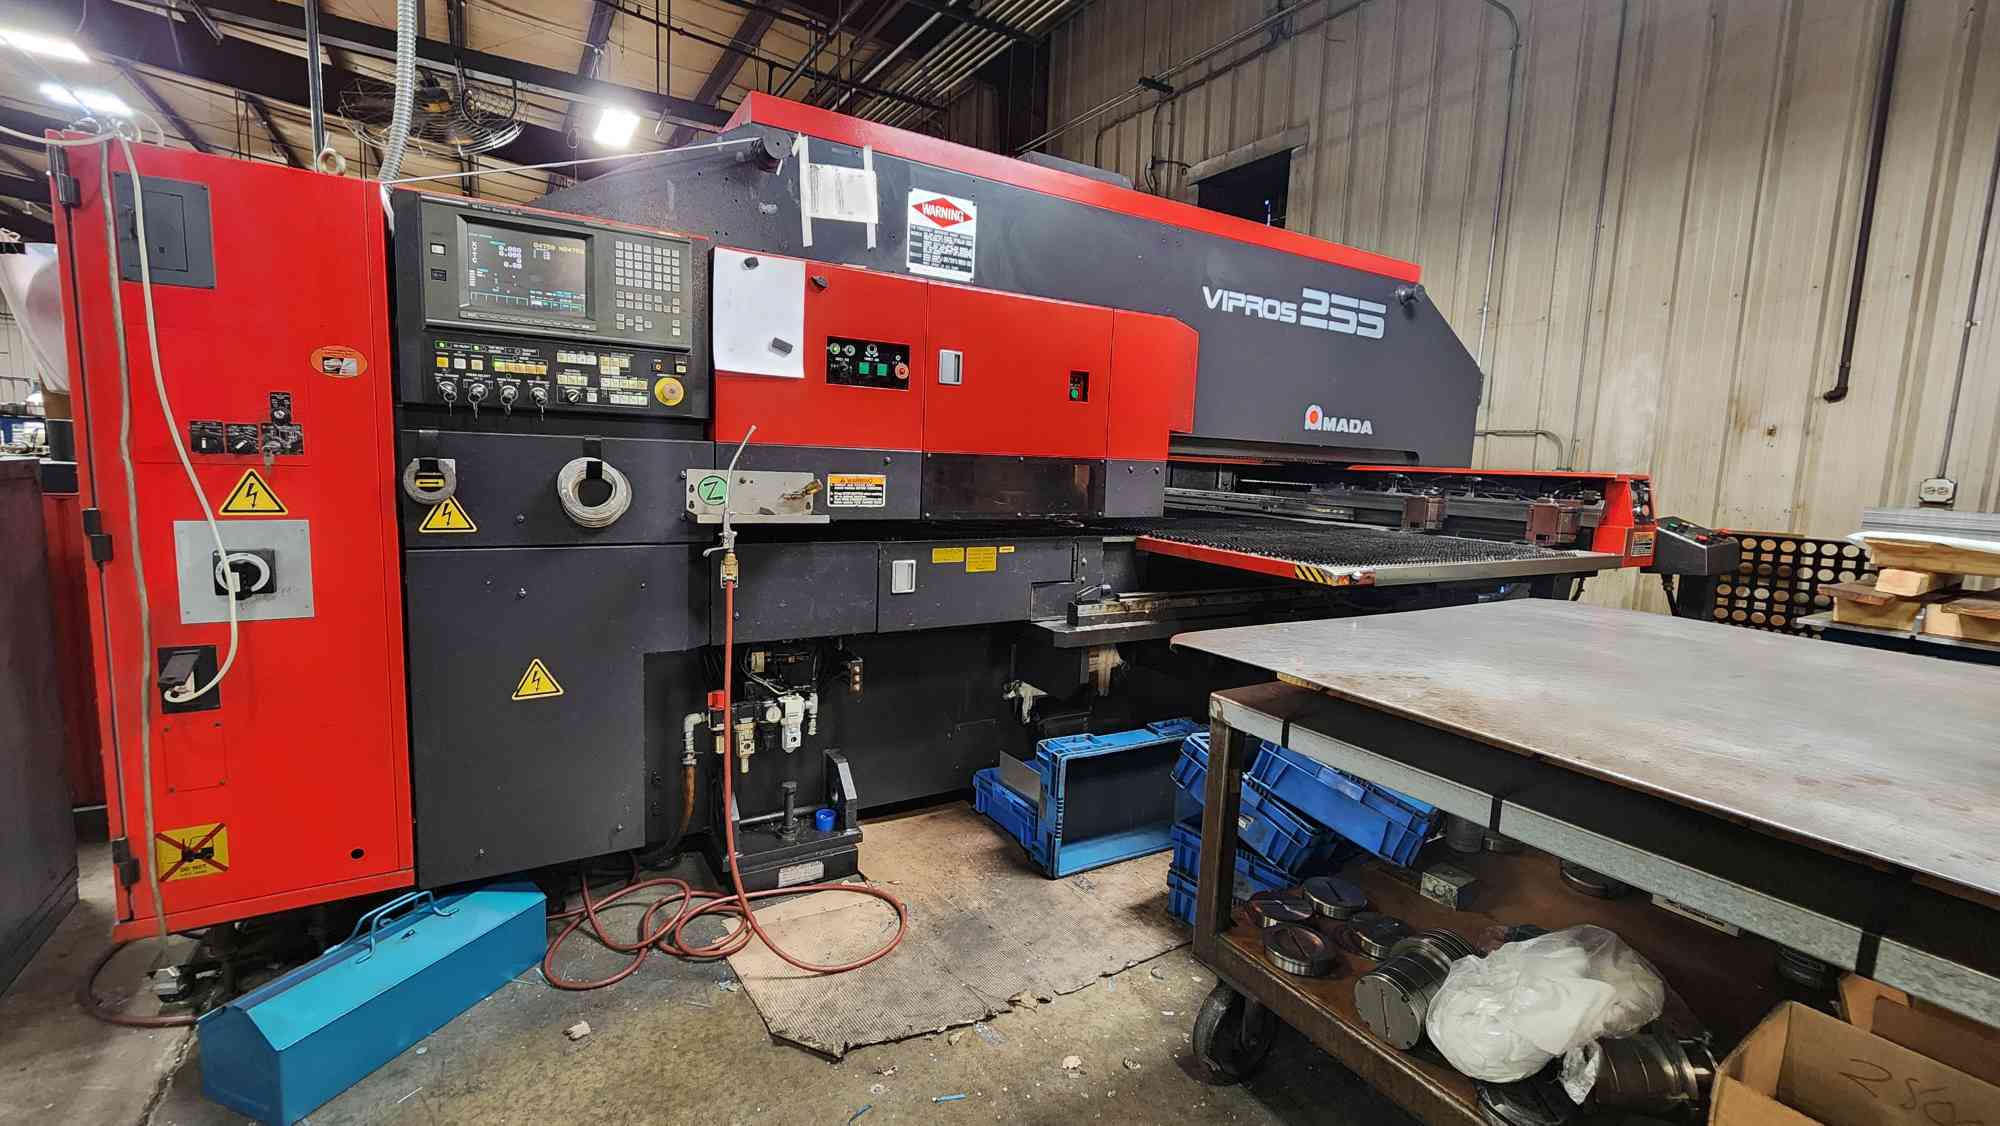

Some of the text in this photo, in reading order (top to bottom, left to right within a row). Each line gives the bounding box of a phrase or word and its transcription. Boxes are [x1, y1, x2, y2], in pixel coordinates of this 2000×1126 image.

[922, 202, 964, 223] WARNING
[1203, 286, 1387, 339] VIPROS 255
[1305, 404, 1373, 435] AMADA
